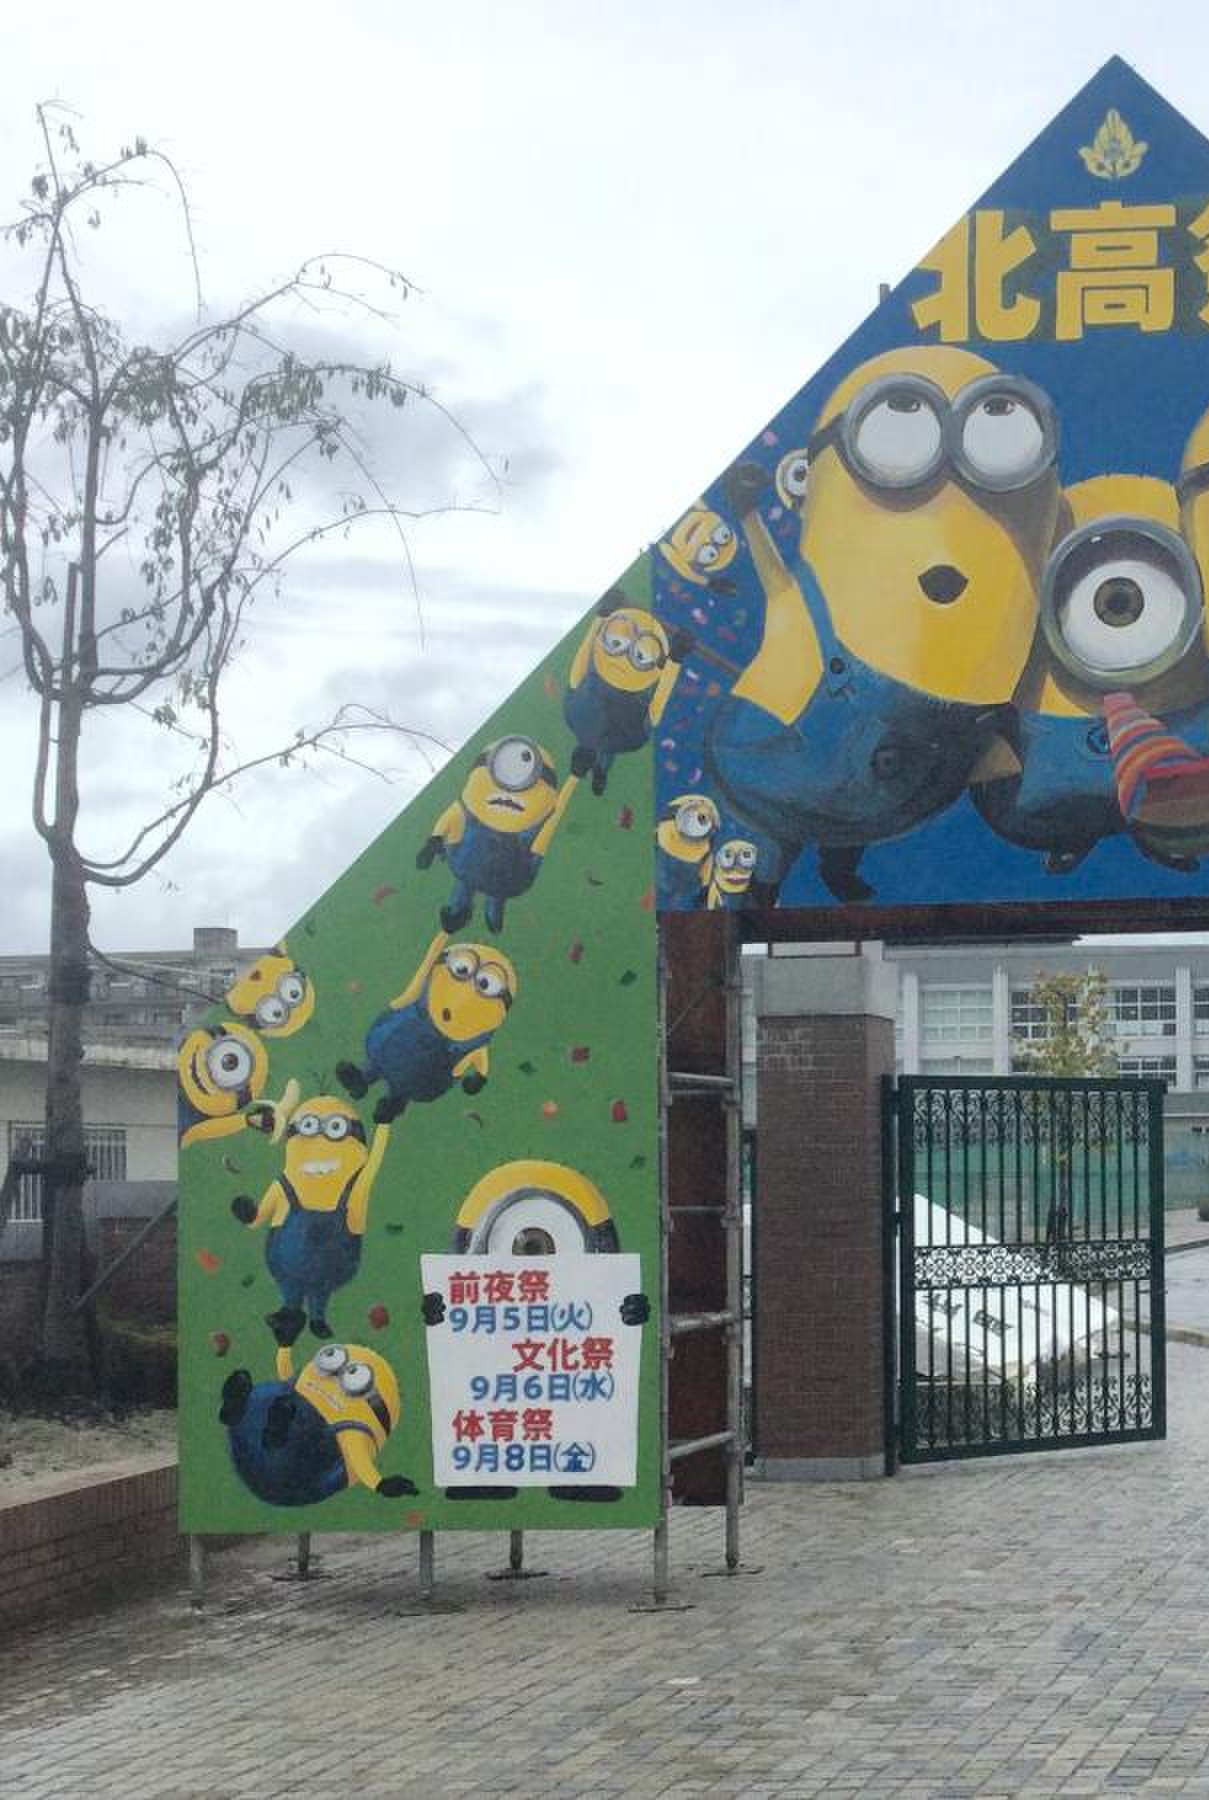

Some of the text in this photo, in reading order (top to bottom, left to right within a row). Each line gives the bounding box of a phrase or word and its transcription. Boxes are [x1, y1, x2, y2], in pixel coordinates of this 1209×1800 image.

[448, 1270, 551, 1304] 前夜祭
[449, 1301, 593, 1333] 9月5日(火)
[511, 1337, 614, 1372] 文化祭
[470, 1372, 615, 1402] 9月6日(水)
[452, 1408, 553, 1442] 体育祭
[452, 1441, 596, 1473] 9月8日(金)
